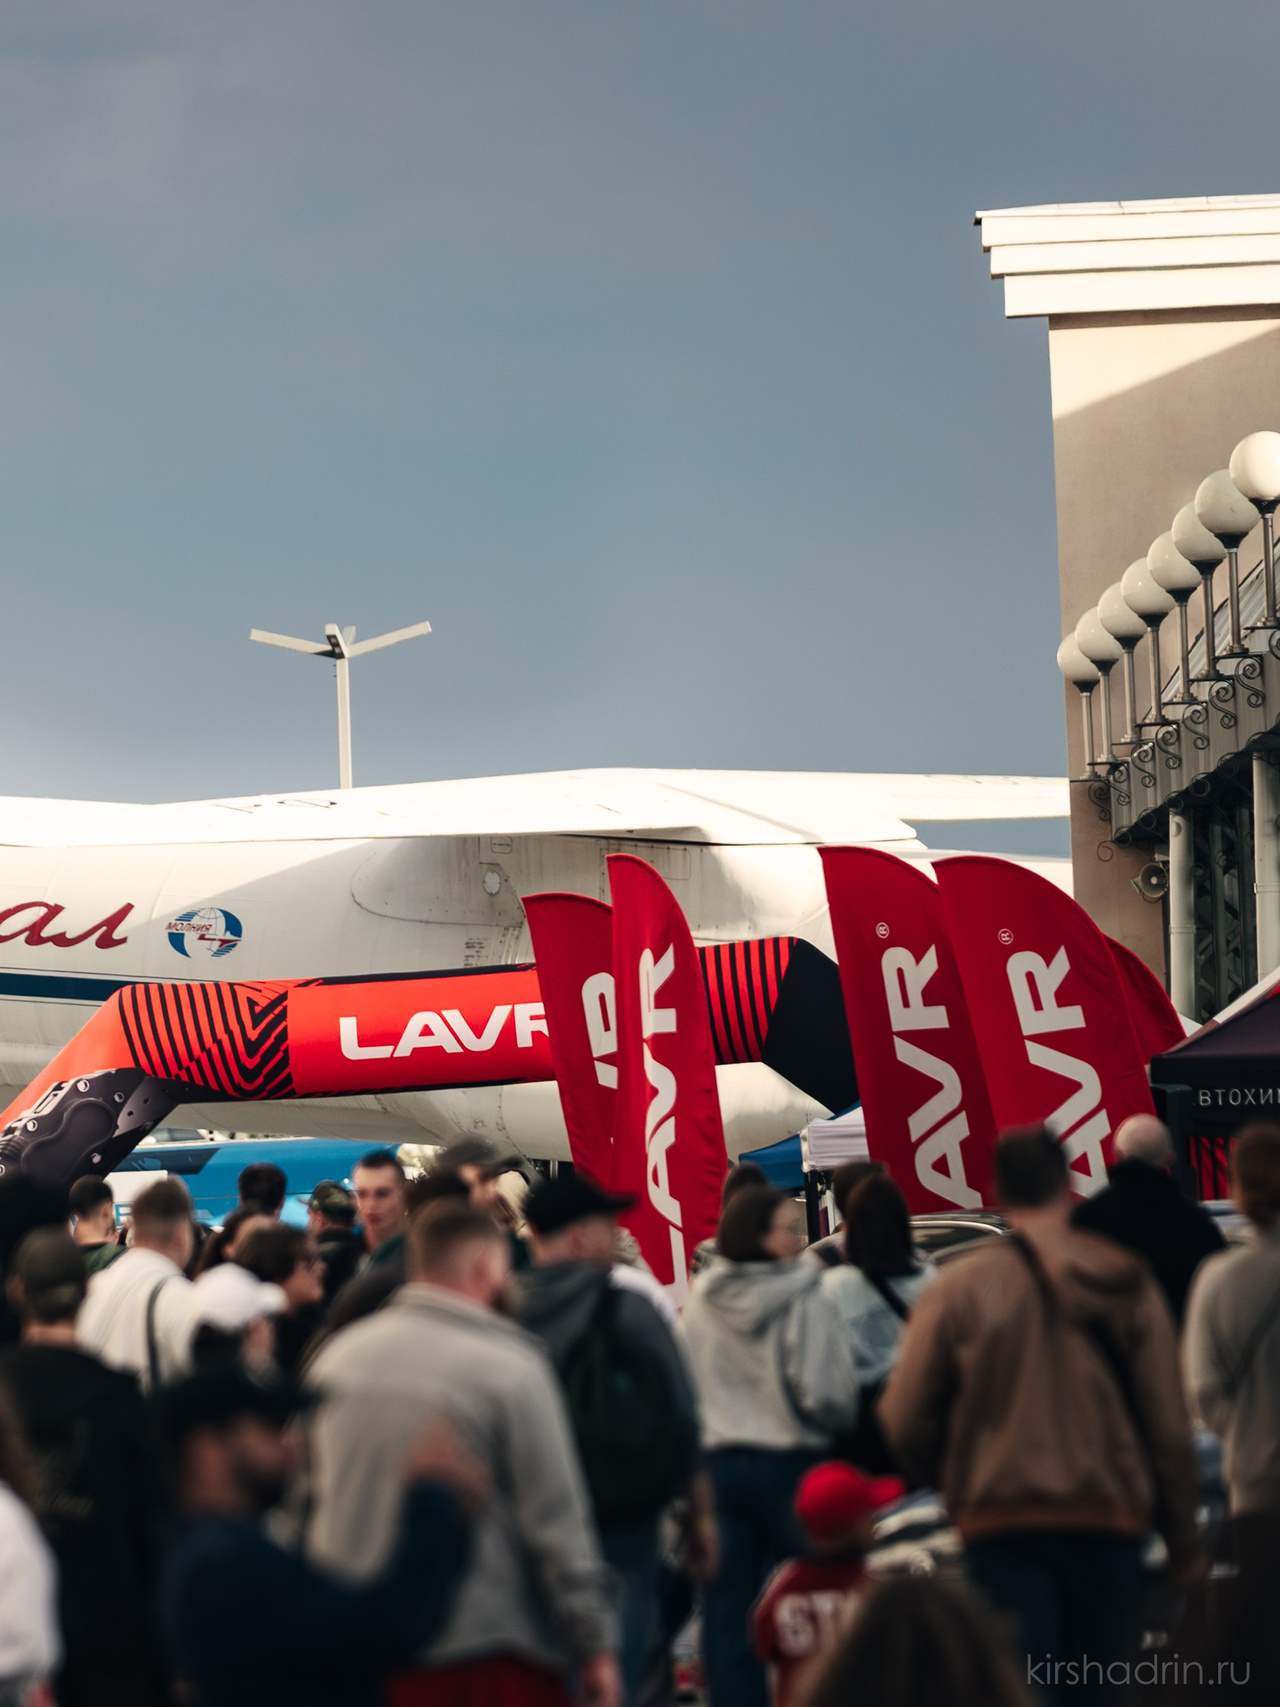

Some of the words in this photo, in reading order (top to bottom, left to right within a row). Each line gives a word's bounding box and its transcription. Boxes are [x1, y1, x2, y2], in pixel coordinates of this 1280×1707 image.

[164, 921, 213, 933] МОЛНИЯ
[639, 943, 688, 1310] LAVR
[881, 943, 983, 1210] AVR
[1006, 944, 1111, 1200] AVR
[1193, 1087, 1280, 1106] ВТОХИ
